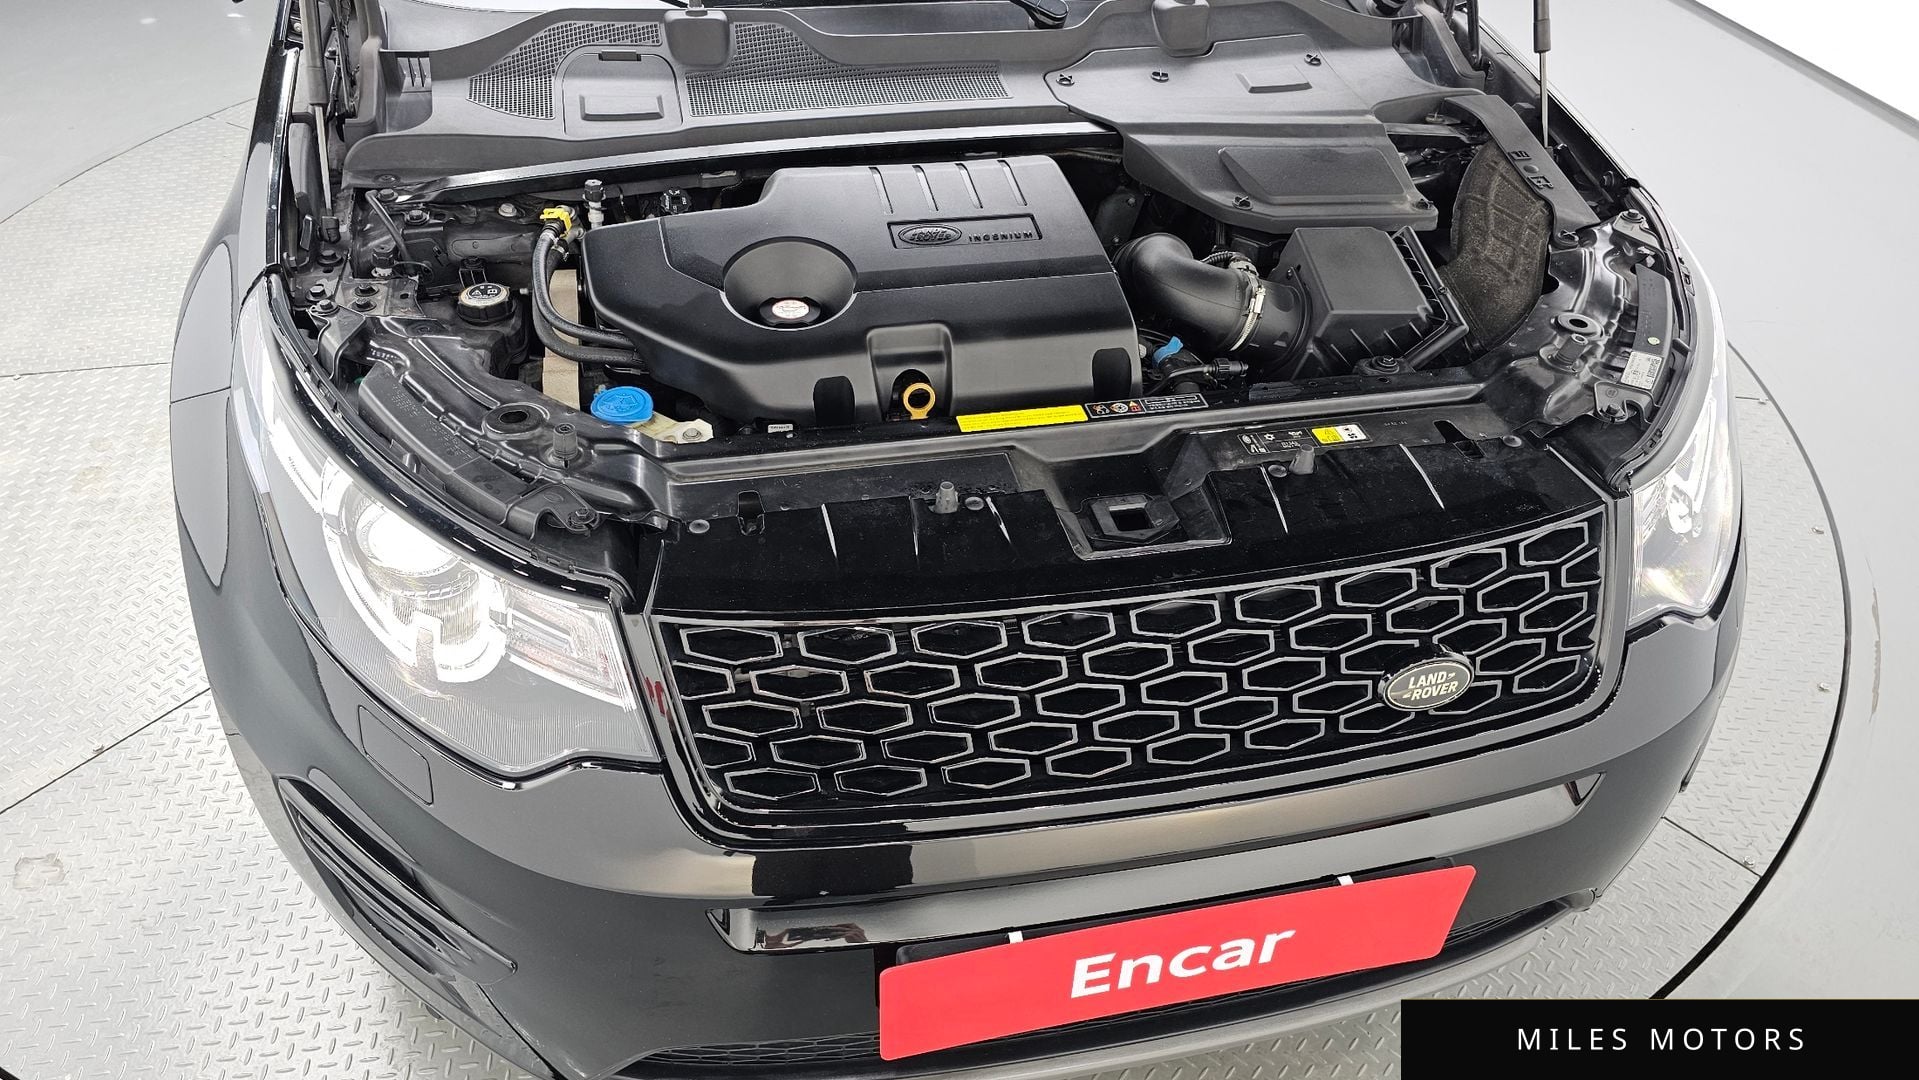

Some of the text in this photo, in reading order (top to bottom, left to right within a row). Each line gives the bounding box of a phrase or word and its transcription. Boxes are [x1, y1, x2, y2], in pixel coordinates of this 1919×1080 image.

[968, 230, 1034, 243] INGENIUM
[1408, 671, 1447, 689] LAND
[1411, 681, 1459, 701] ROVER
[1070, 929, 1297, 999] Encar
